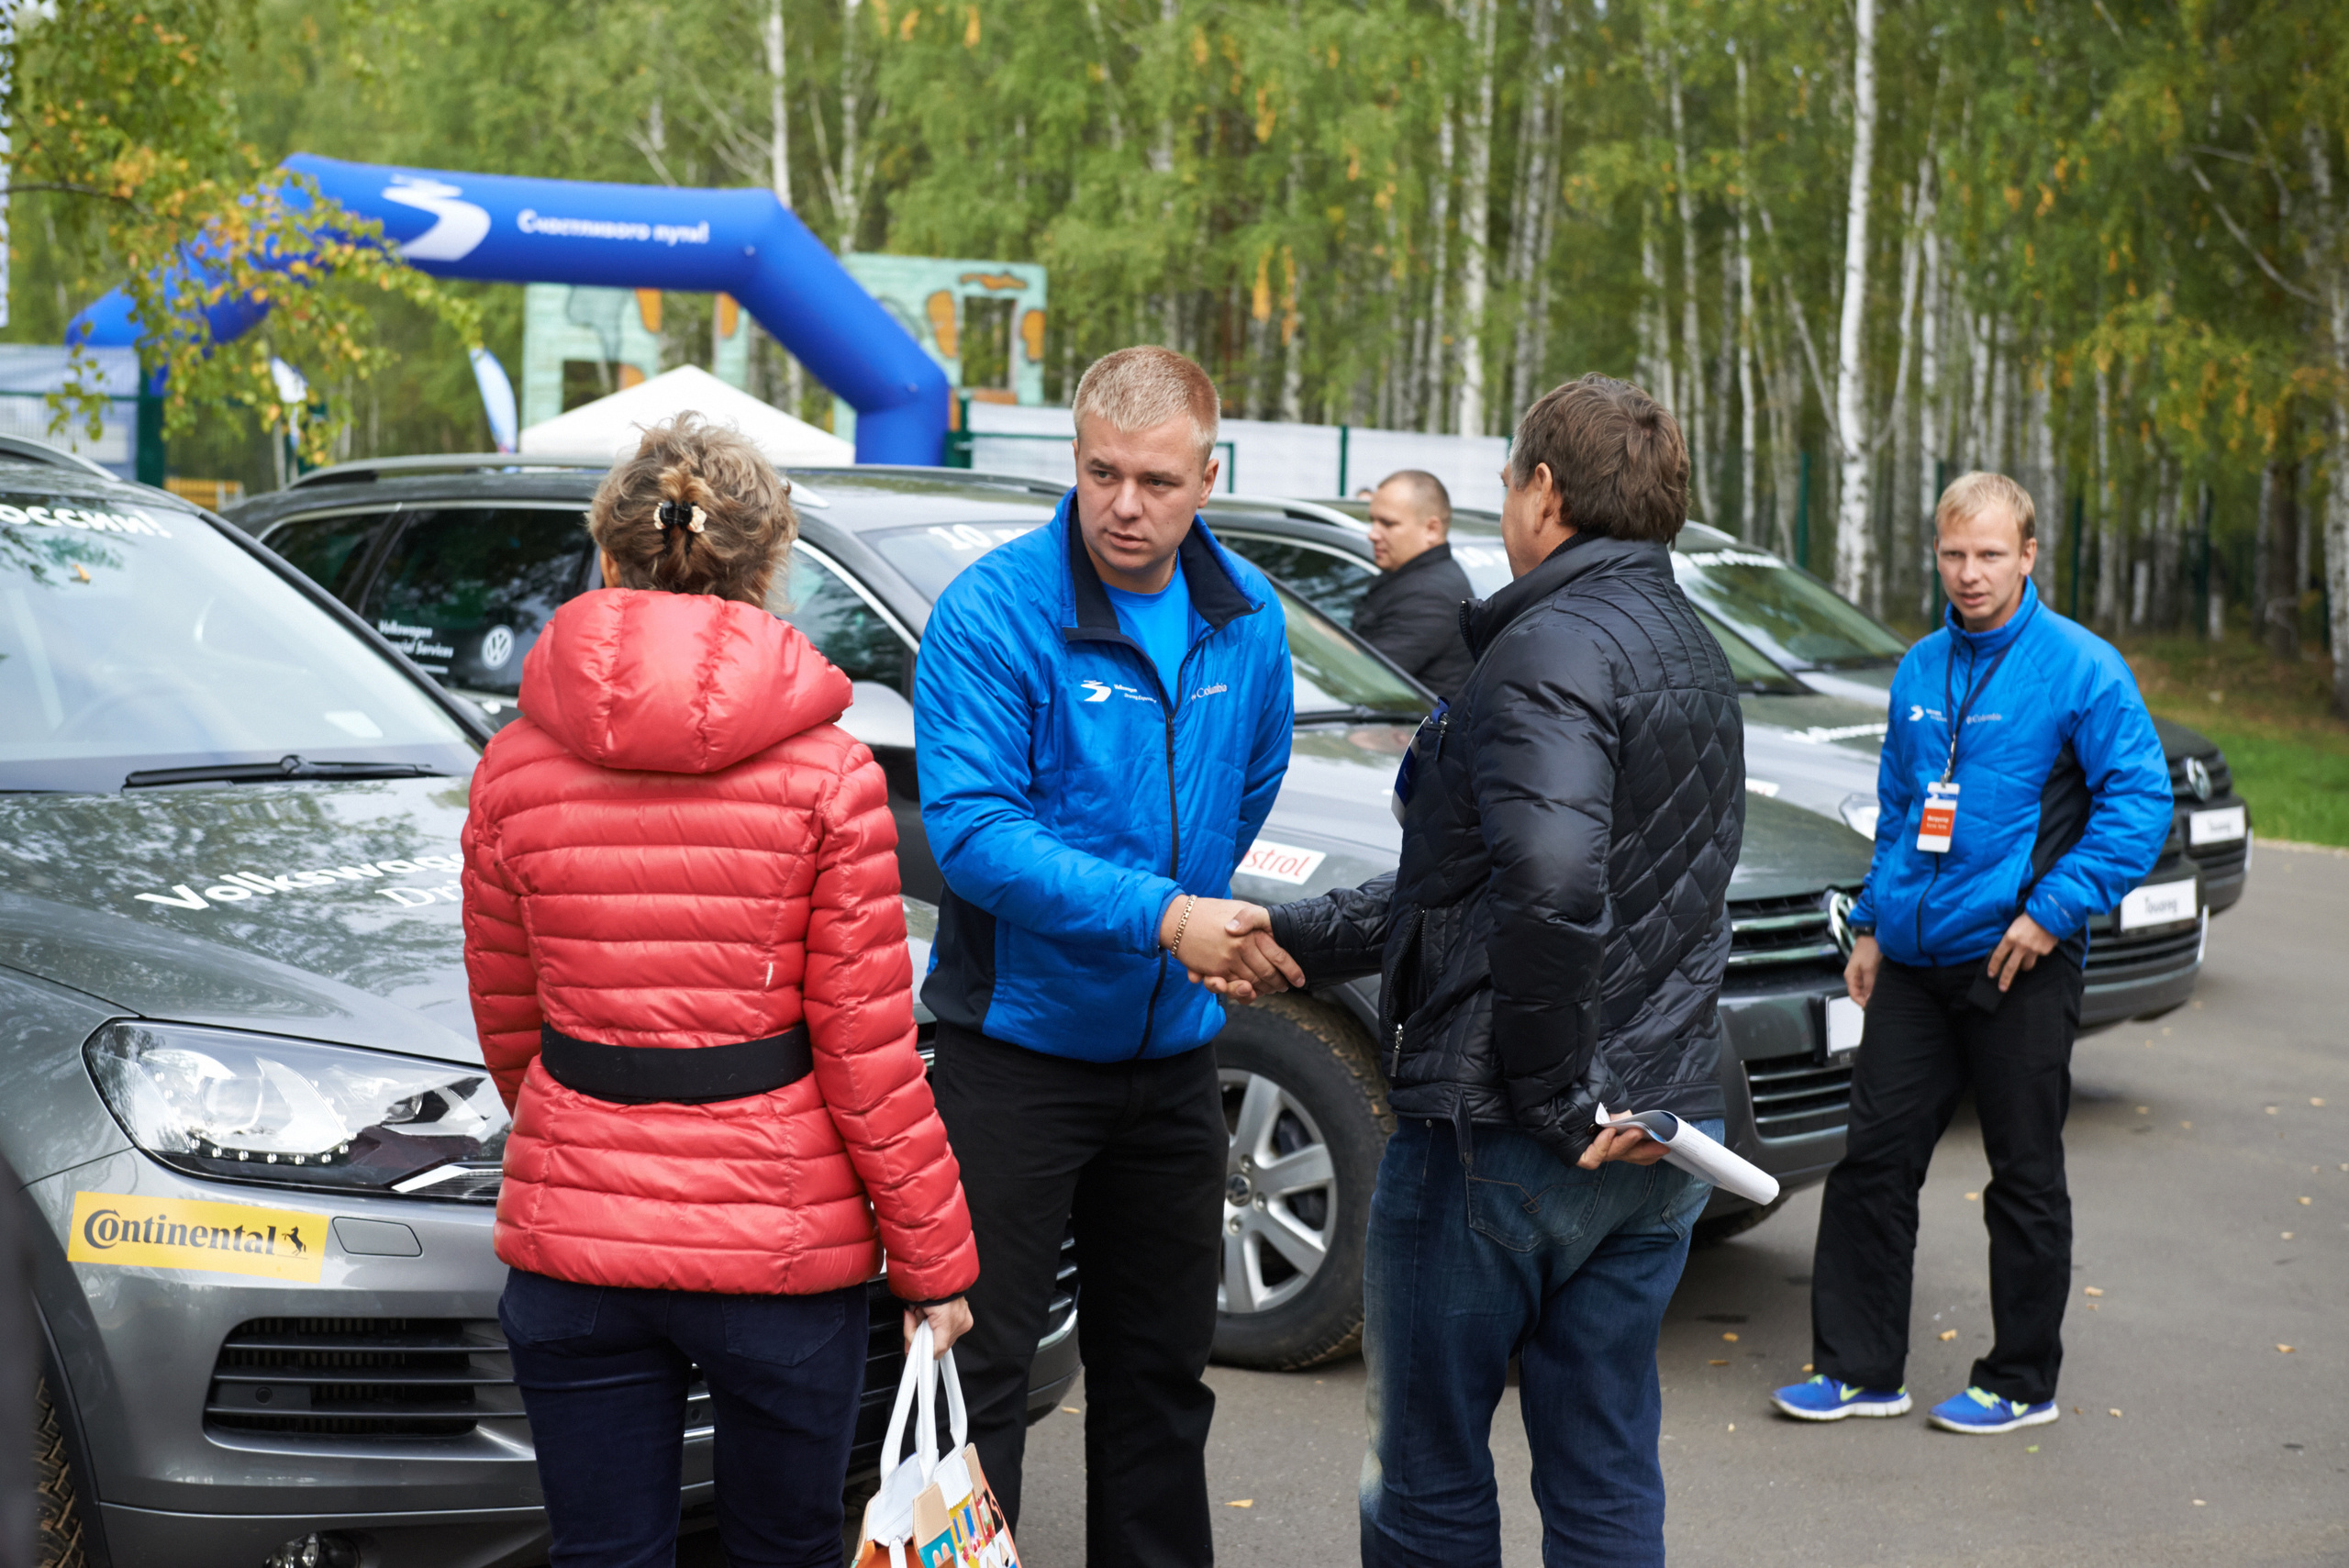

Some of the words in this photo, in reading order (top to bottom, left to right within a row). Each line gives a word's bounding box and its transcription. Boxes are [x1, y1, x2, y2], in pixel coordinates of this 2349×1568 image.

[0, 504, 173, 539] оссии!
[927, 524, 993, 550] 10
[1196, 683, 1228, 698] Columbia
[1240, 849, 1311, 877] strol
[134, 852, 465, 910] Volkswag
[83, 1208, 276, 1256] Continental
